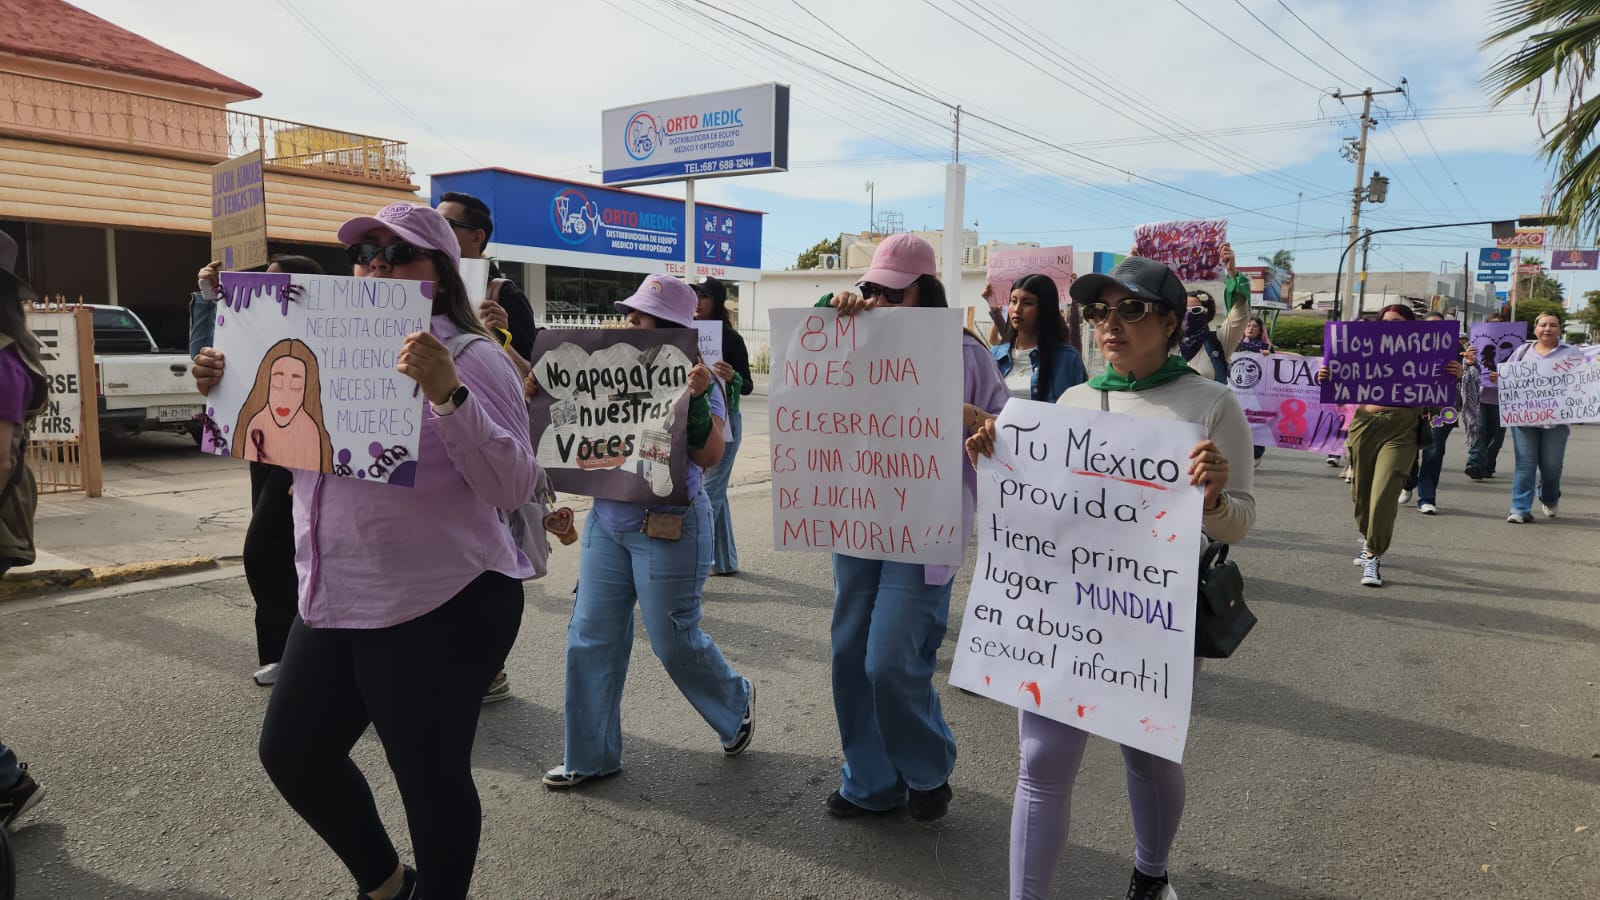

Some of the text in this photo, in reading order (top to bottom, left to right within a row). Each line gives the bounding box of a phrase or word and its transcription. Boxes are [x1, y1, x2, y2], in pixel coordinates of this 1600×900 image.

[667, 108, 742, 133] ORTO MEDIC
[669, 129, 740, 146] DISTRIBUIDORA DE EQUIPO
[684, 157, 754, 173] TEL:687 688 1244
[606, 229, 677, 245] DISTRIBUIDORA DE EQUIPO
[1057, 255, 1071, 265] NO
[307, 280, 407, 310] EL MUNDO
[306, 317, 423, 338] NECESITA CIENCIA
[1380, 331, 1452, 355] MARCHO
[546, 353, 687, 400] No apagarán
[785, 358, 919, 387] NO ES UNA
[1328, 360, 1441, 382] POR LAS QUE
[1499, 362, 1540, 379] CAUSA
[1500, 373, 1575, 390] INCOMODIDAD
[329, 377, 398, 401] NECESITA
[1357, 384, 1384, 402] NO
[1391, 381, 1448, 404] ESTÁN
[1499, 388, 1568, 402] UNA PARIENTE
[42, 417, 75, 434] HRS.
[337, 408, 414, 437] MUJERES
[1277, 398, 1307, 437] 8
[1502, 409, 1556, 424] VIOLADOR
[1560, 409, 1574, 420] EN
[773, 444, 941, 480] ES UNA JORNADA
[1065, 428, 1179, 483] México
[779, 485, 906, 512] DE LUCHA Y
[783, 518, 916, 554] MEMORIA
[990, 513, 1179, 588] tiene primer
[984, 552, 1184, 632] lugar MUNDIAL
[974, 604, 1103, 645] en abuso
[969, 636, 1169, 699] sexual infantil
